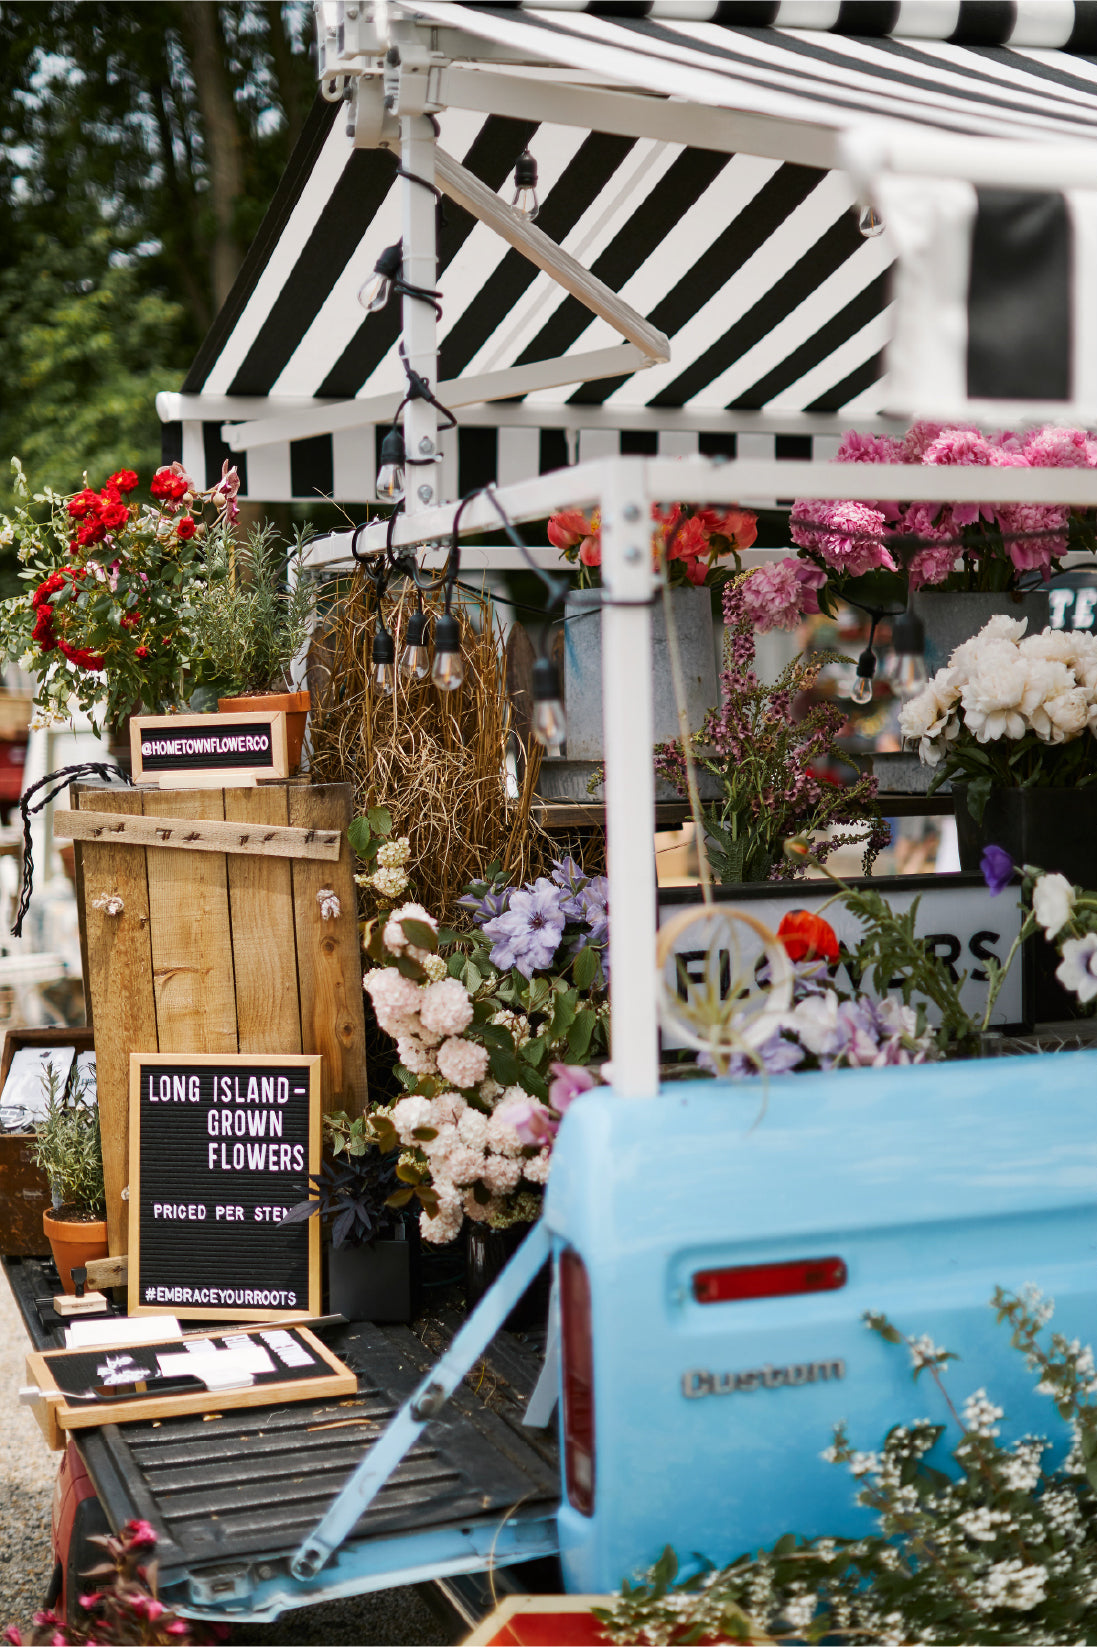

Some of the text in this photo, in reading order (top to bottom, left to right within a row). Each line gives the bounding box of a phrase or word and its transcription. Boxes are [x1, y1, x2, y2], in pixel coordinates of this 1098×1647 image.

[141, 735, 269, 756] @HOMETOWNFLOWERCO
[675, 930, 1001, 1002] FLWRS
[149, 1075, 306, 1104] LONG ISLAND-
[207, 1109, 283, 1137] GROWN
[208, 1142, 305, 1171] FLOWERS
[153, 1203, 207, 1220] PRICED
[215, 1205, 245, 1221] PER
[145, 1286, 297, 1306] #EMBRACEYOURROOTS
[682, 1358, 846, 1399] Custom
